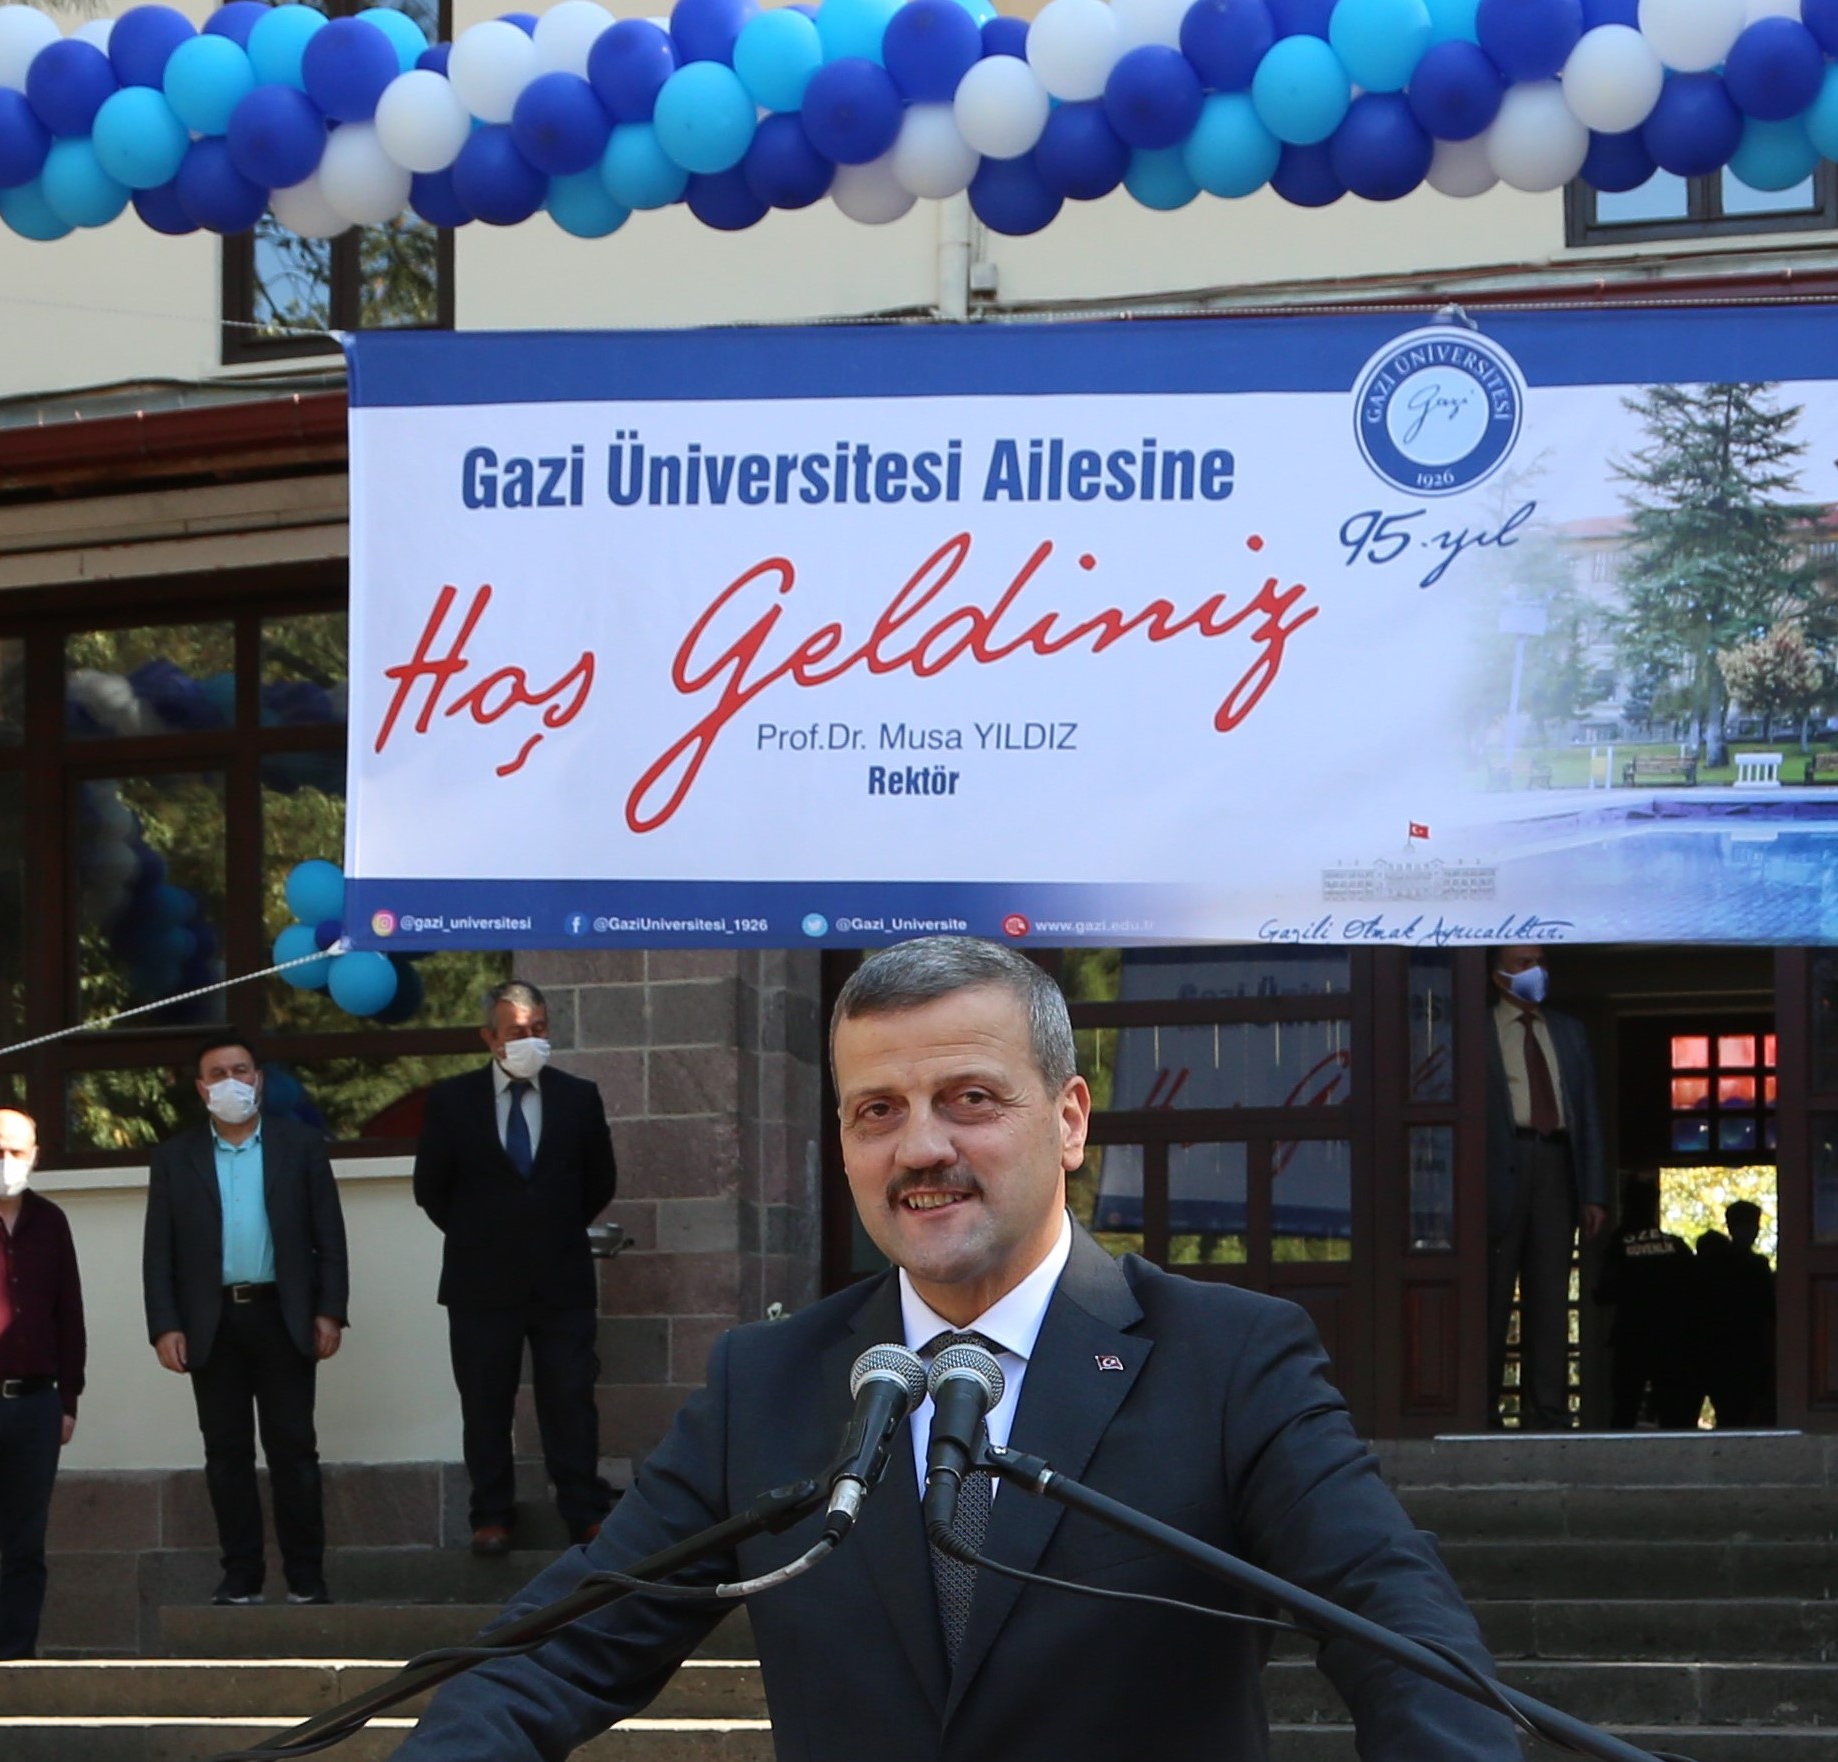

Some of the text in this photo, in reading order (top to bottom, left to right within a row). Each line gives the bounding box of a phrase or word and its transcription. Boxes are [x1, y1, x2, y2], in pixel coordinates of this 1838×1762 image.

[462, 430, 1235, 510] Gazi Üniversitesi Ailesine
[1416, 470, 1455, 489] 1926
[375, 532, 1321, 834] Hoş Geldiniz
[757, 722, 1079, 751] Prof.Dr. Musa YILDIZ
[868, 764, 960, 796] Rektör
[399, 915, 532, 934] @gazi_universitesi
[593, 917, 769, 935] @GaziUniversitesi_1926
[835, 917, 968, 935] @Gazi_Universite
[1258, 914, 1333, 945] Gazili
[1342, 914, 1424, 941] Olmak
